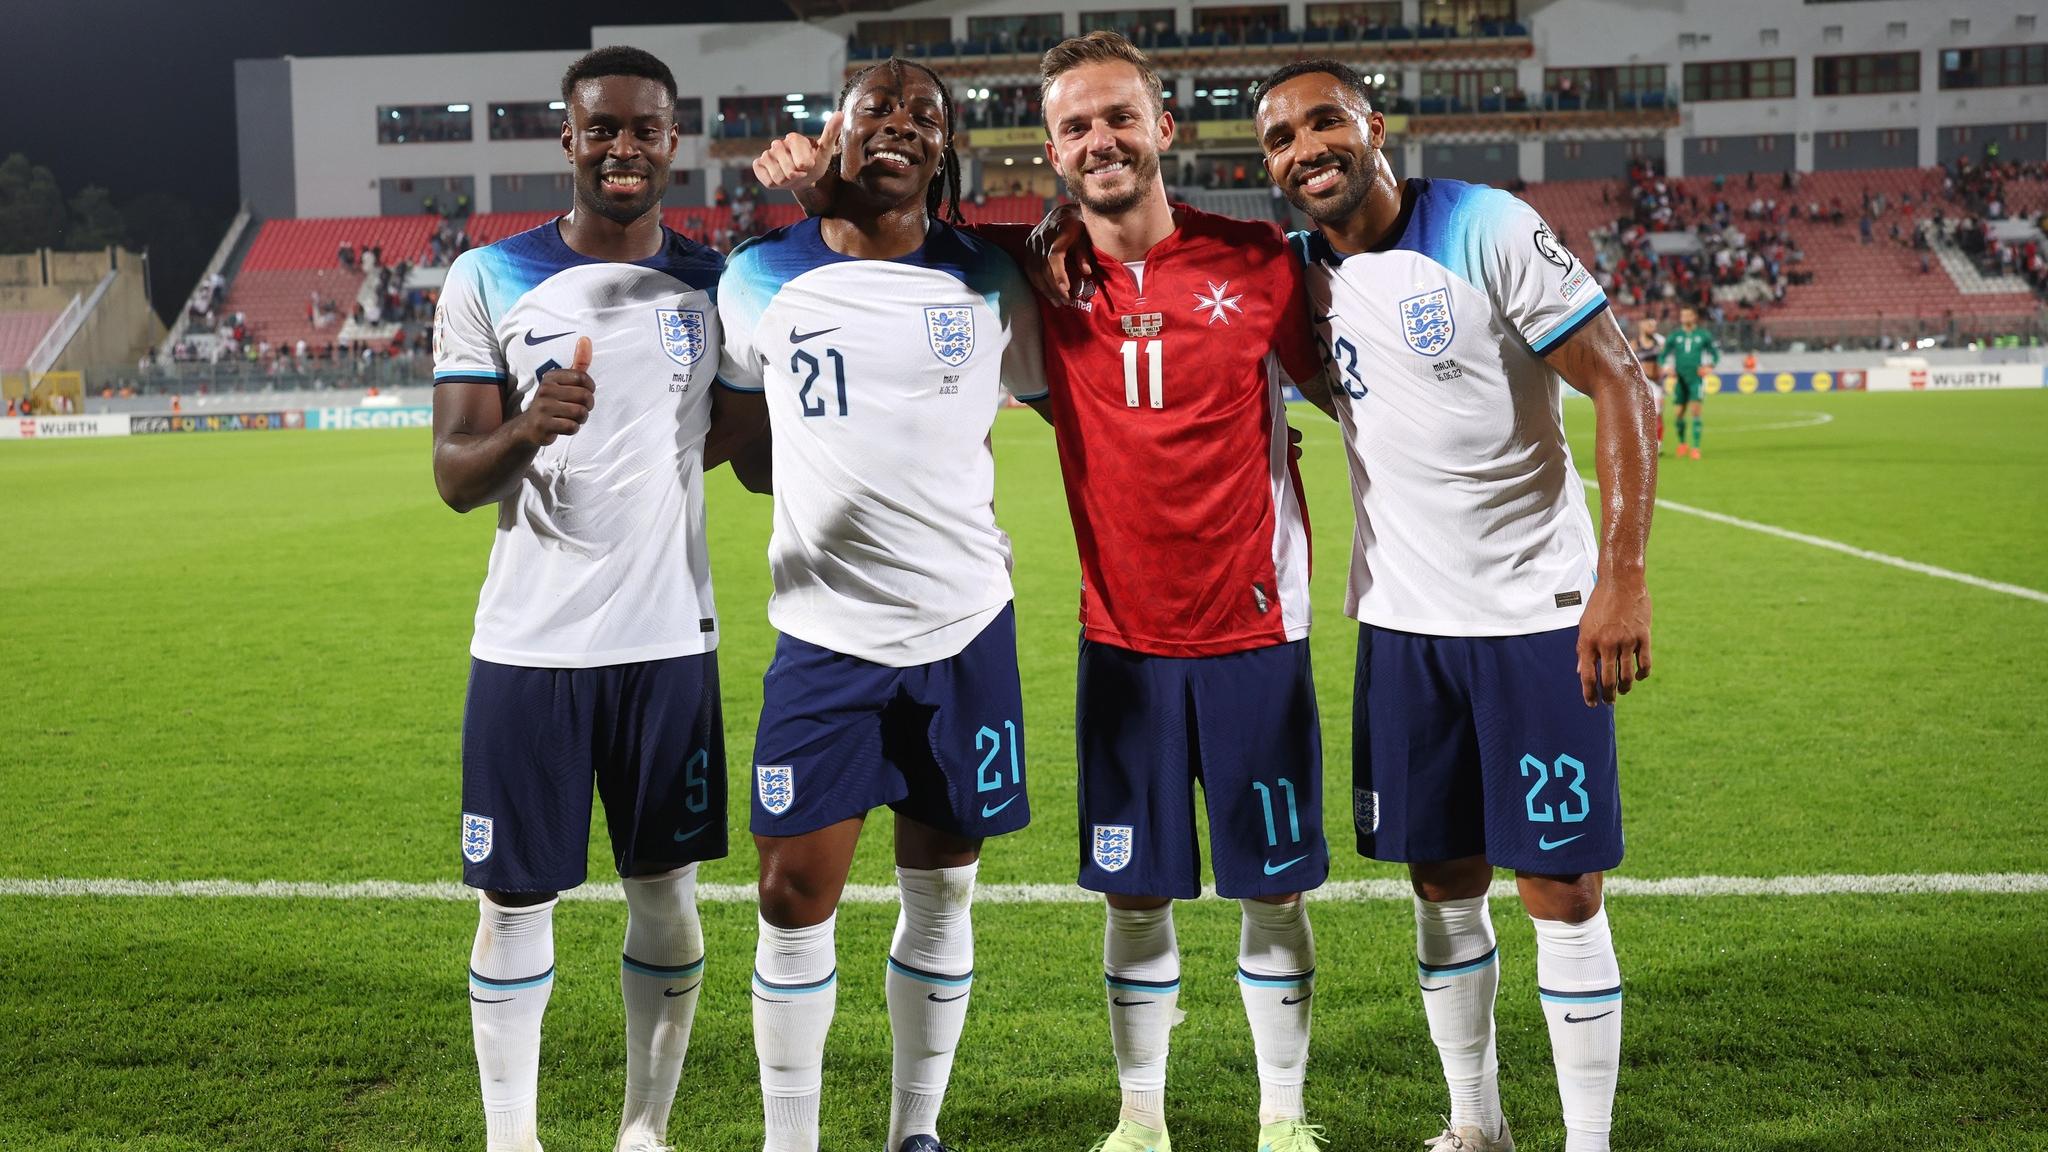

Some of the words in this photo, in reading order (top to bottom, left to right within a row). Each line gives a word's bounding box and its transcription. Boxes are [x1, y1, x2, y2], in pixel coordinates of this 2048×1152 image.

[790, 348, 848, 417] 21
[1119, 340, 1164, 409] 11
[1432, 359, 1456, 372] MALTA
[172, 412, 281, 432] FOUNDATION
[318, 406, 432, 429] Hisens
[685, 749, 709, 813] 5
[976, 720, 1019, 793] 21
[1520, 753, 1590, 823] 23
[1253, 778, 1301, 846] 11
